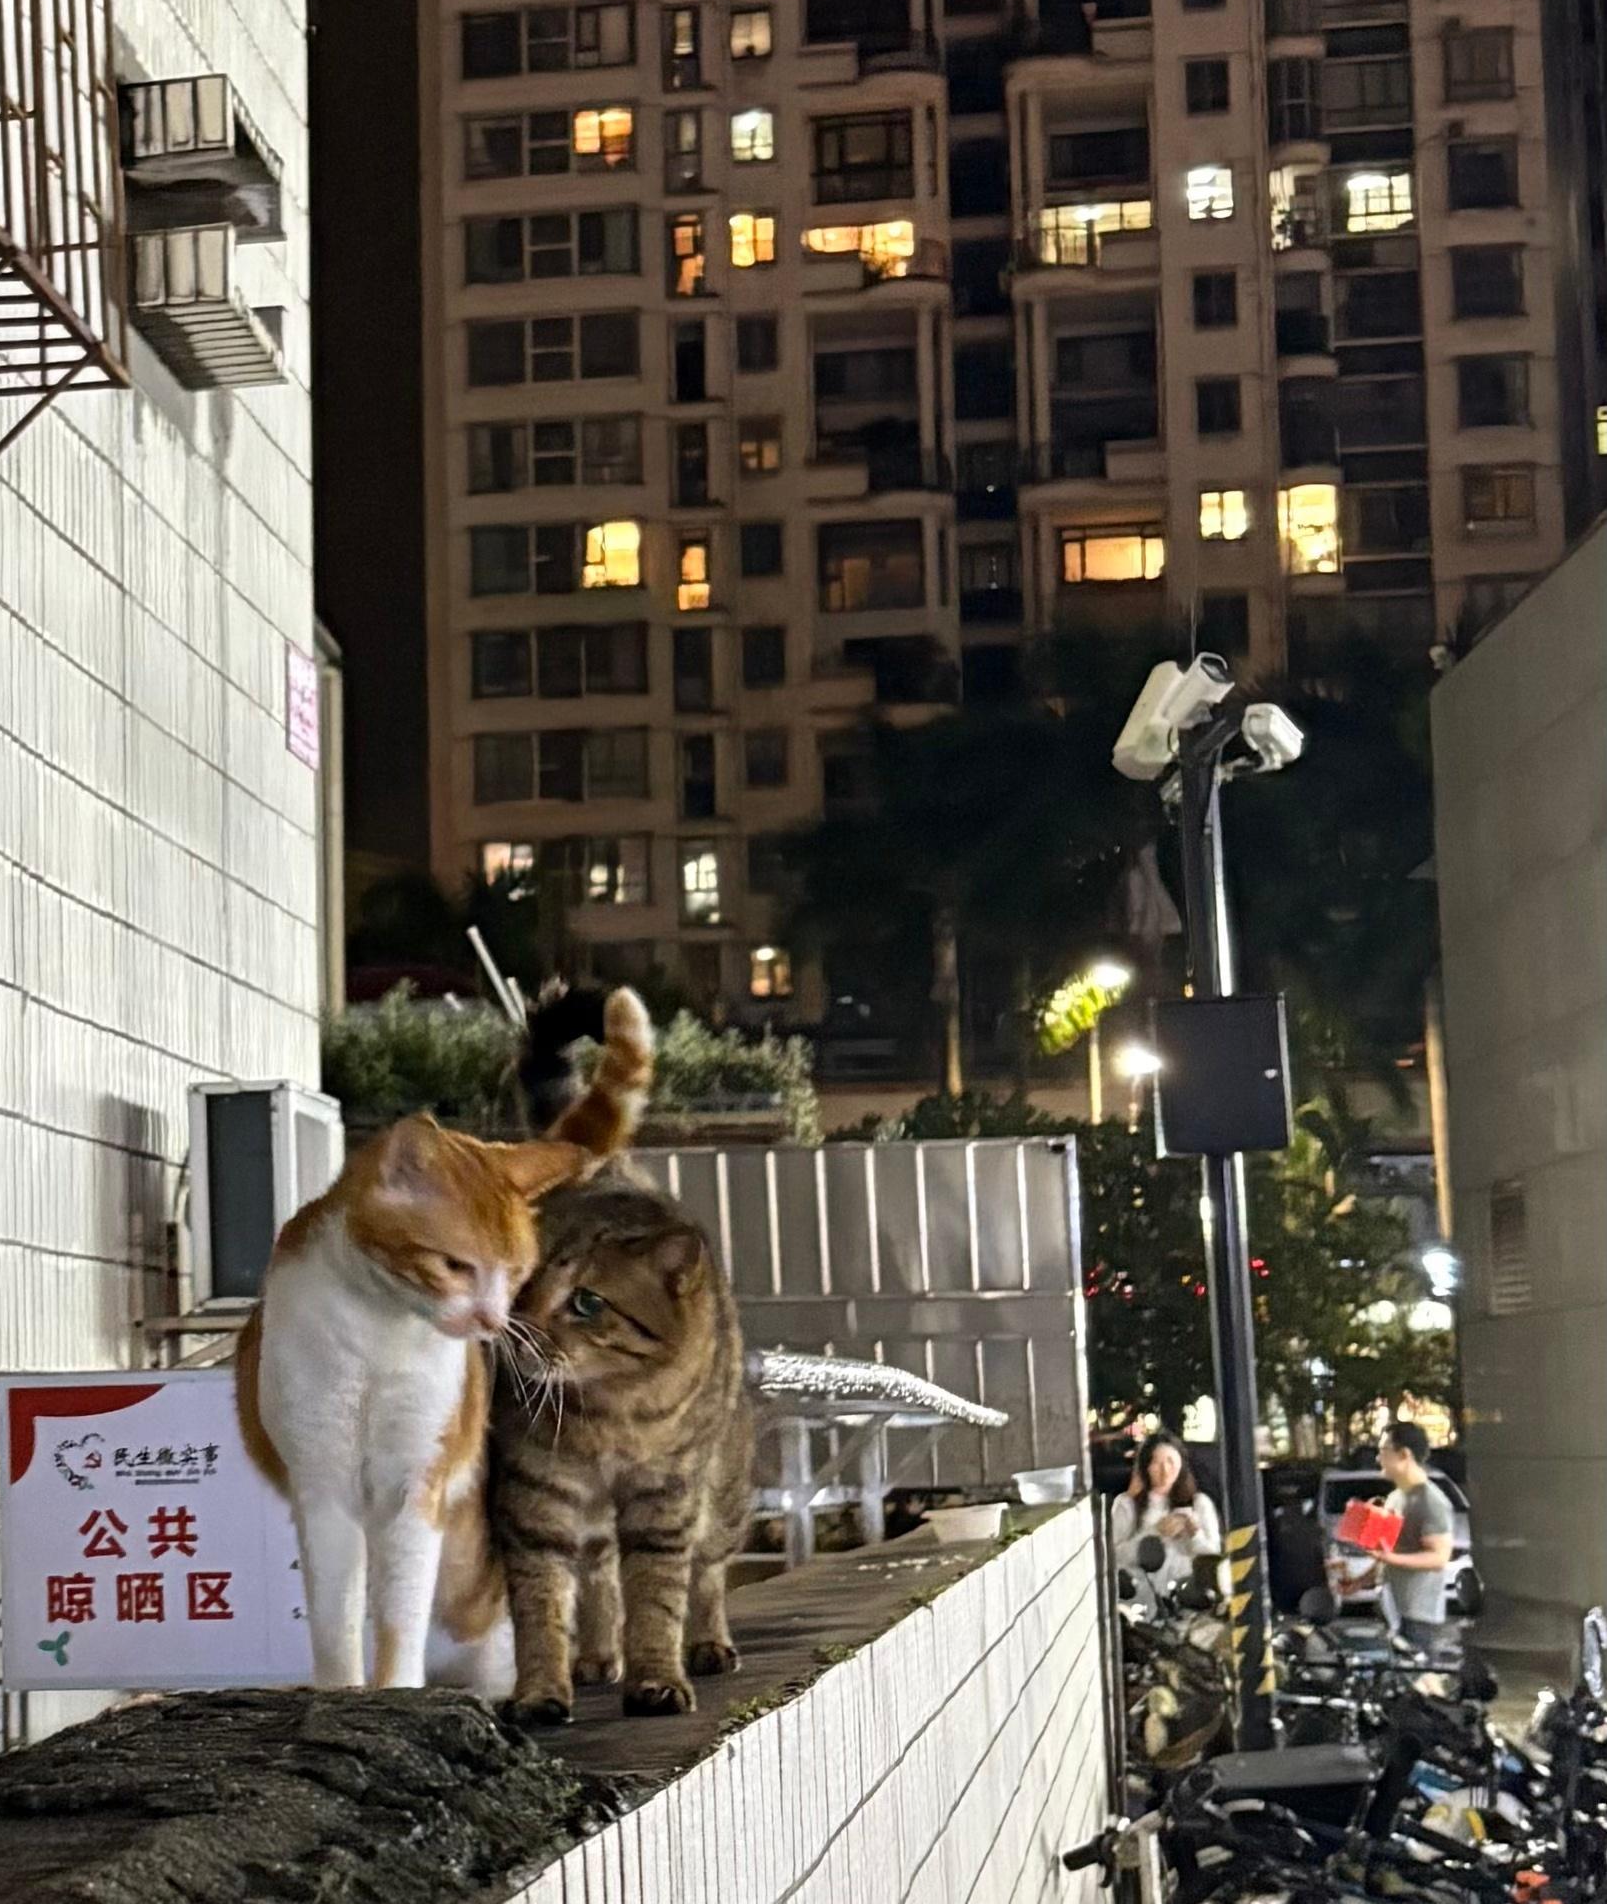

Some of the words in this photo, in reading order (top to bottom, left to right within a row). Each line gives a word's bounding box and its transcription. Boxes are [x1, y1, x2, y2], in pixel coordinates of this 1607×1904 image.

[113, 1442, 221, 1468] 民生微实事
[78, 1505, 199, 1559] 公共
[46, 1571, 234, 1624] 晾晒区
